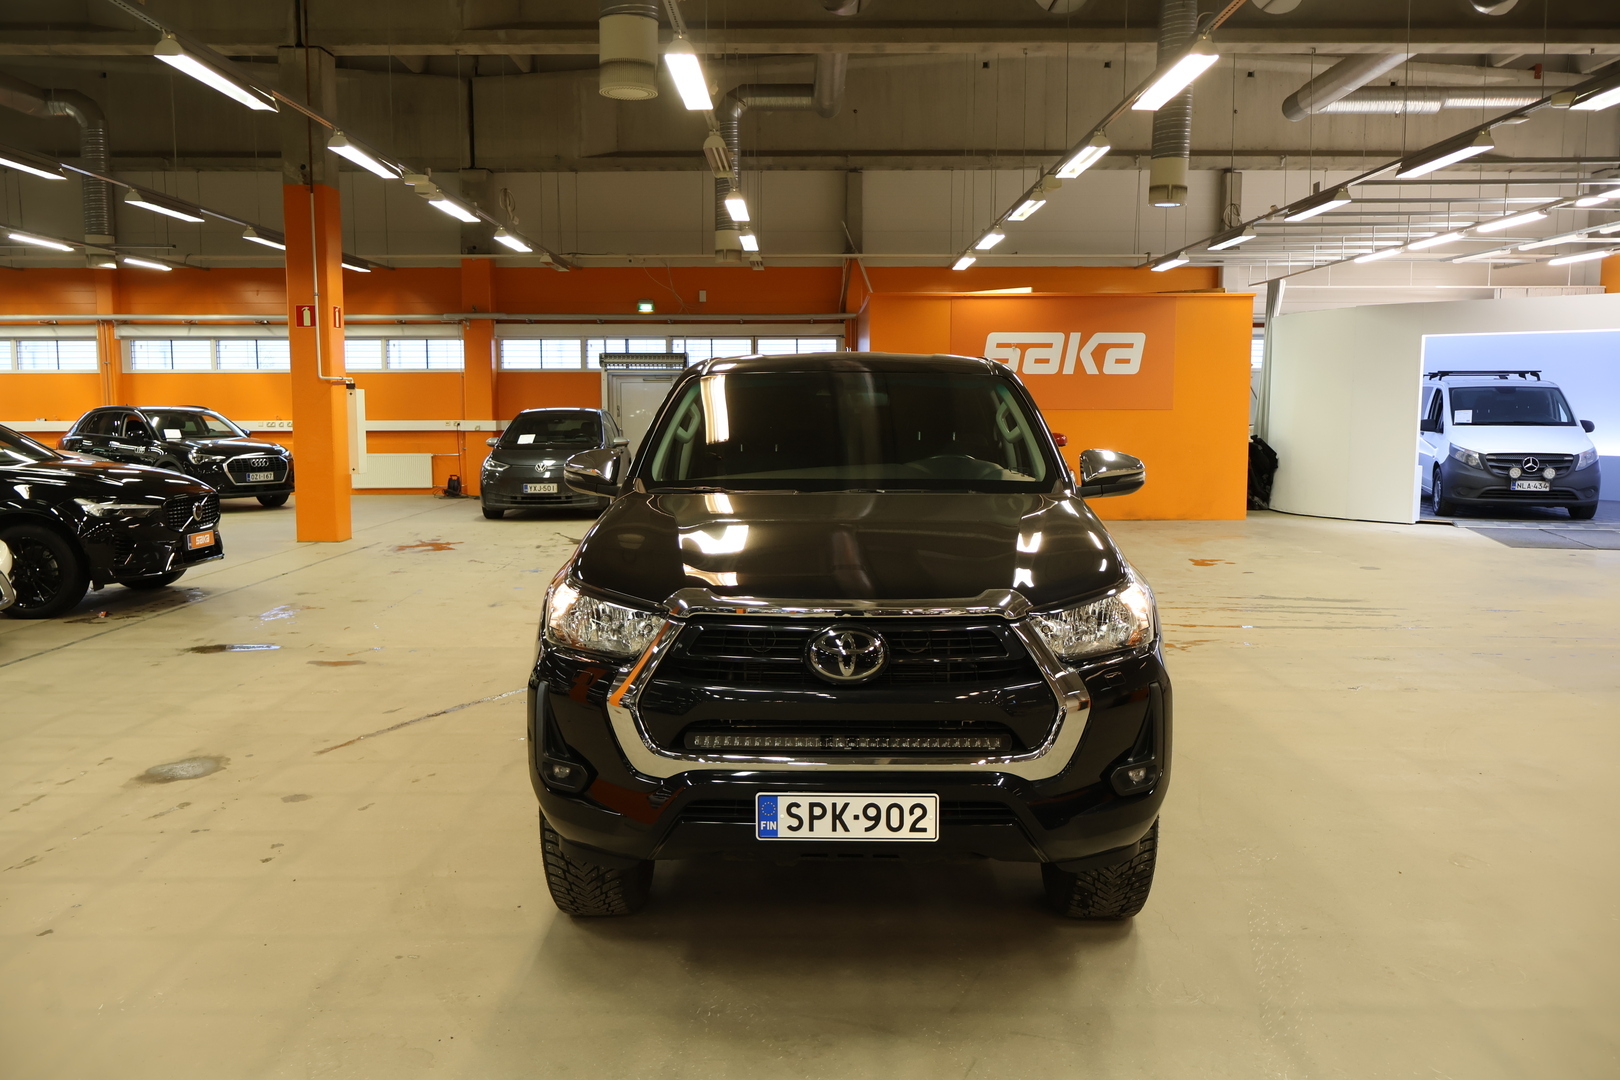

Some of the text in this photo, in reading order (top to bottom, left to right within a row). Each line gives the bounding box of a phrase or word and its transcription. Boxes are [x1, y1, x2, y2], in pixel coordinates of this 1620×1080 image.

[1516, 482, 1548, 490] NLA-434
[760, 801, 928, 832] FIN SPK-902
